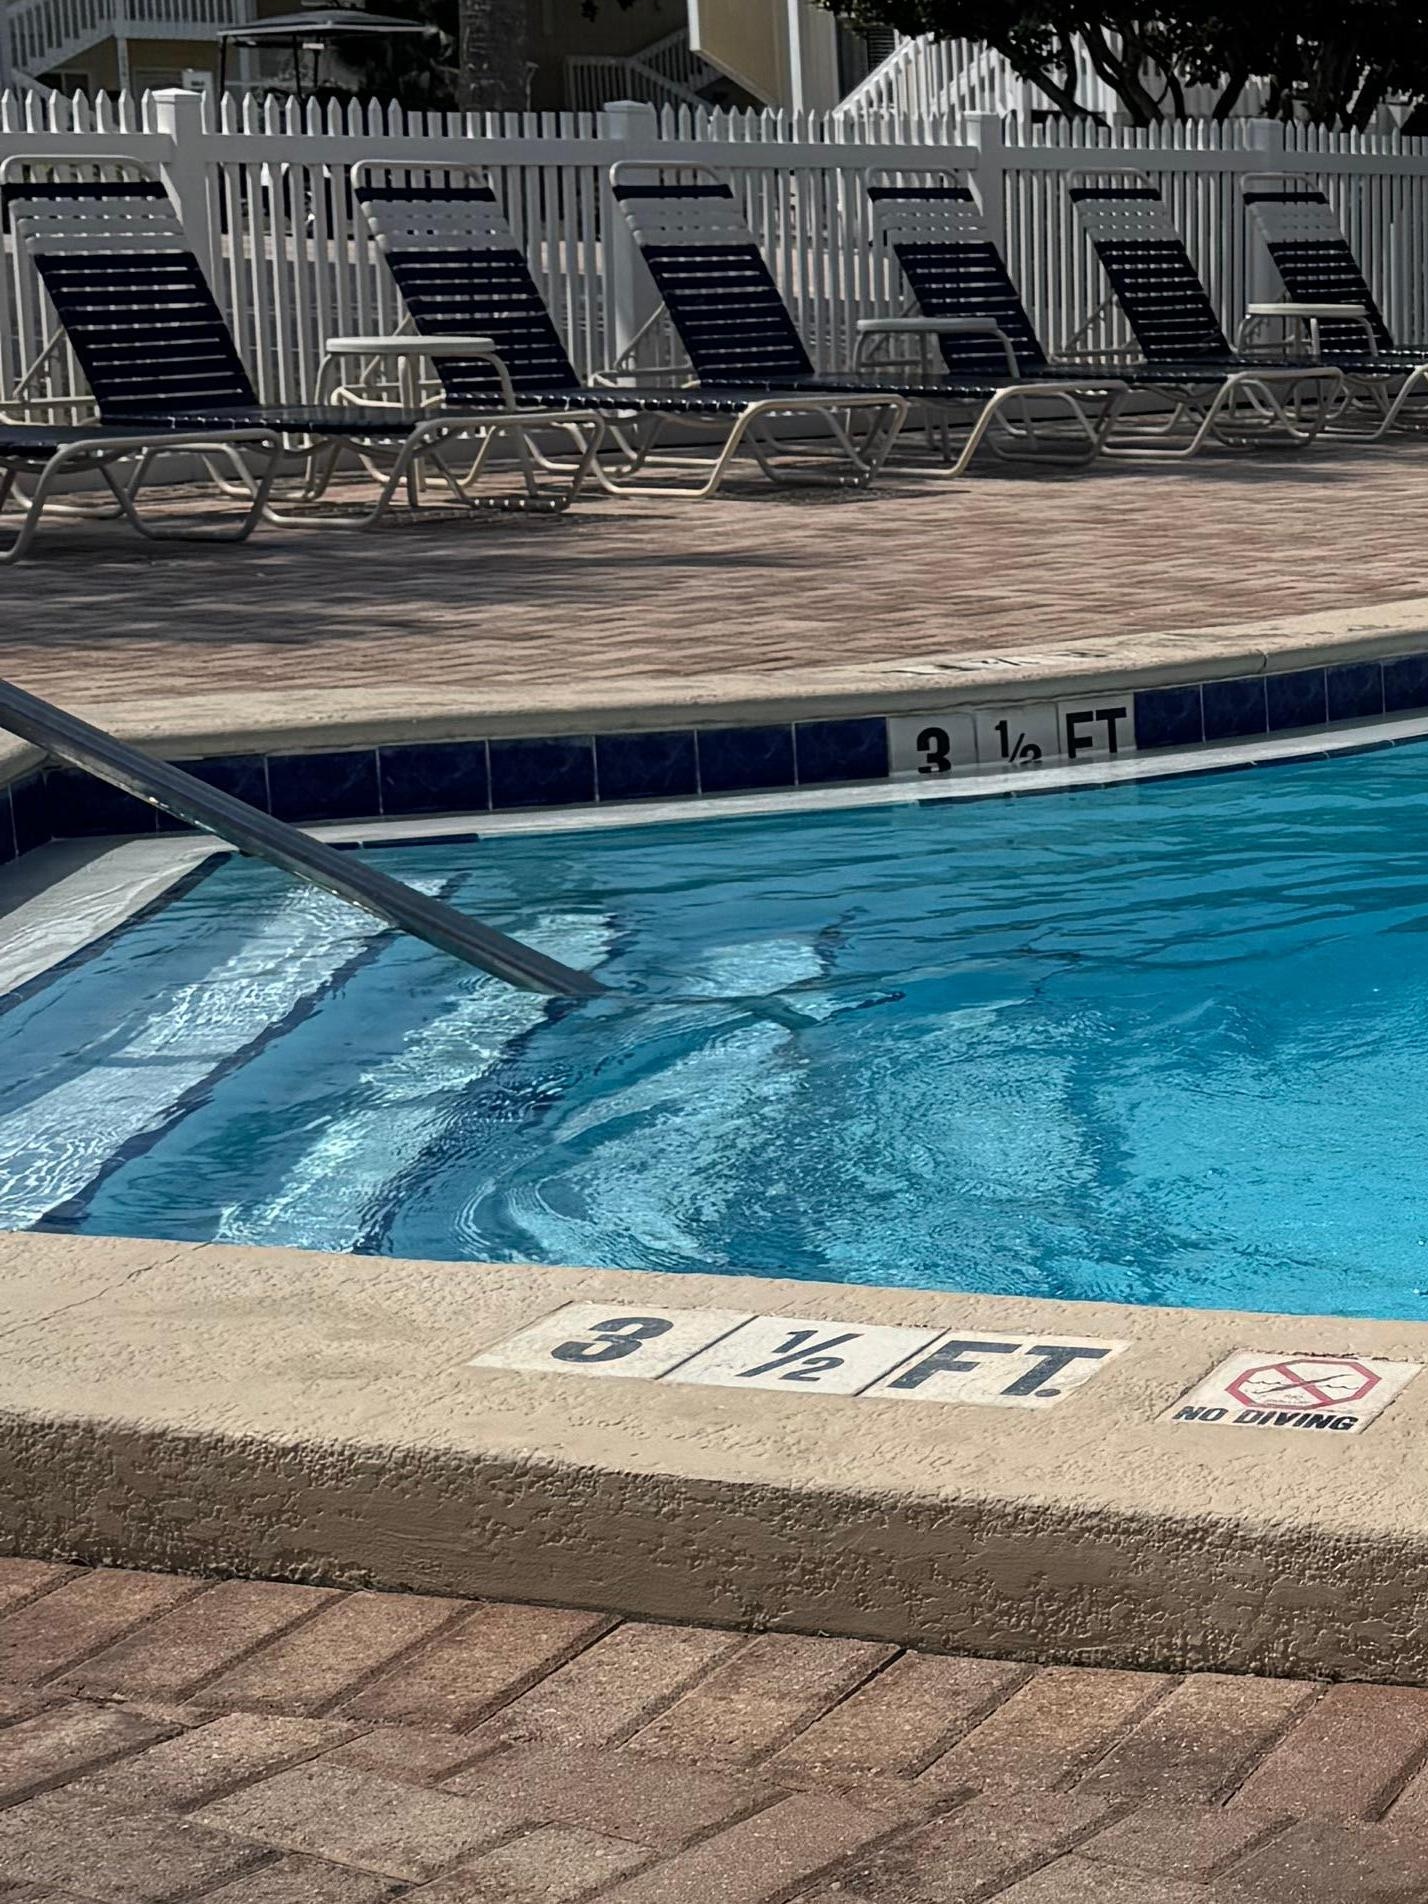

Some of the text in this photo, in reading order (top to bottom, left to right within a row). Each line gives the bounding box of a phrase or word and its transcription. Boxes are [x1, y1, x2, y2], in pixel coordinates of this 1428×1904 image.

[916, 727, 952, 774] 3
[1065, 707, 1128, 759] FT
[550, 1316, 674, 1363] 3
[886, 1339, 1113, 1398] FT.
[1172, 1405, 1360, 1432] NO DIVING
